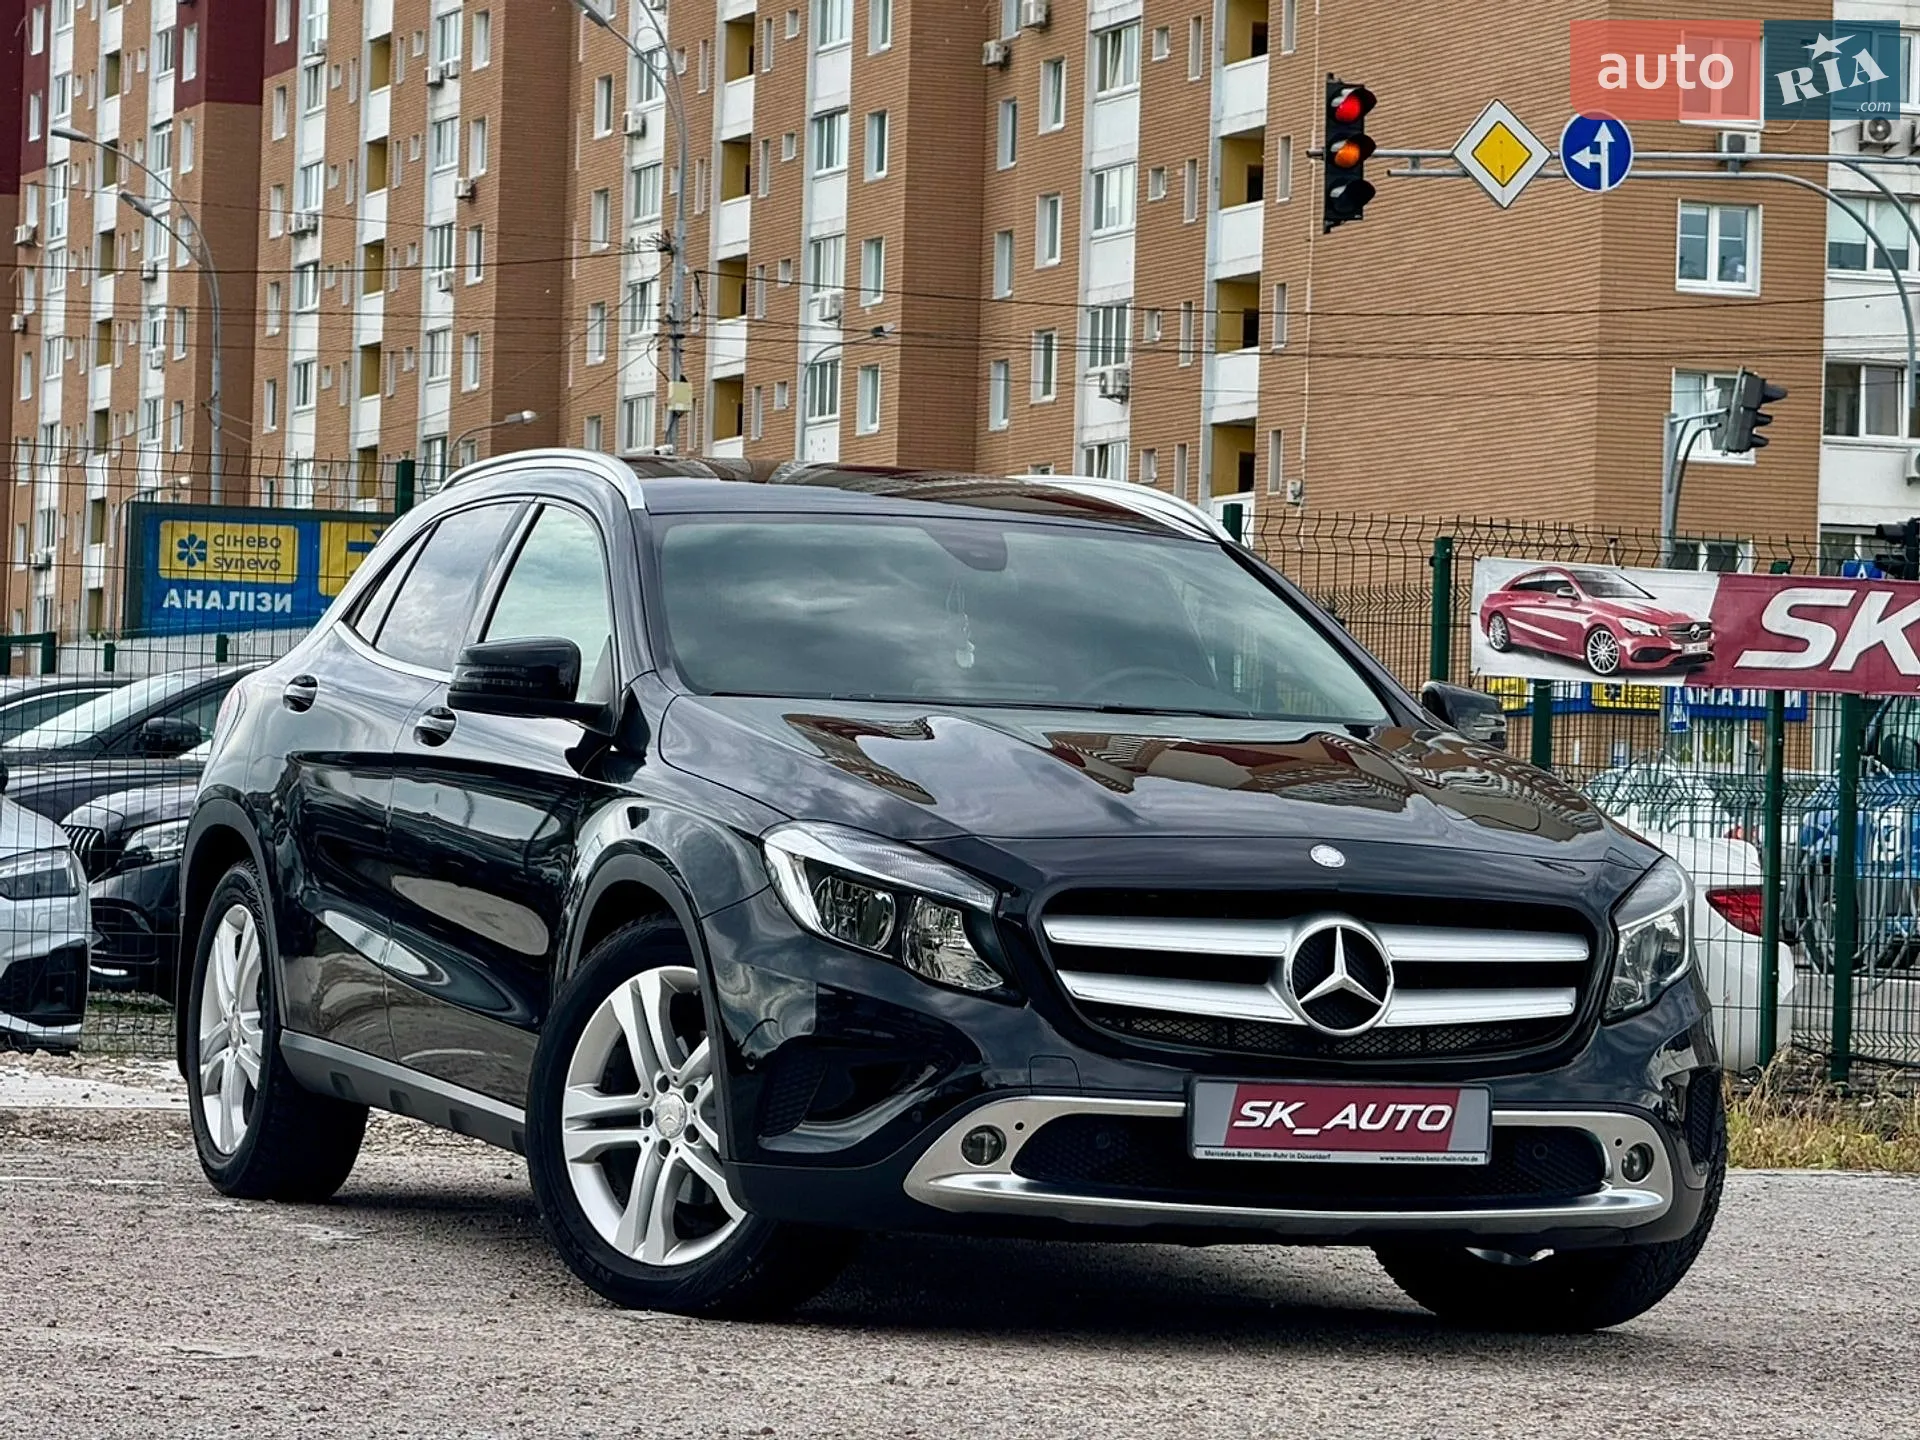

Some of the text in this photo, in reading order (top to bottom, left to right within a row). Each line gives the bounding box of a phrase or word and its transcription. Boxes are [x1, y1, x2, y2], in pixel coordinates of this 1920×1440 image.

[213, 556, 281, 572] synevo
[162, 588, 292, 613] АНАЛІЗИ
[1232, 1100, 1453, 1136] SK_AUTO
[1204, 1149, 1252, 1158] Mercedes-Benz
[1253, 1151, 1288, 1159] Rhein-Ruhr
[1297, 1152, 1332, 1160] Düsseldorf
[1379, 1154, 1479, 1163] www.mercedes-benz-rhein-ruhr.de
